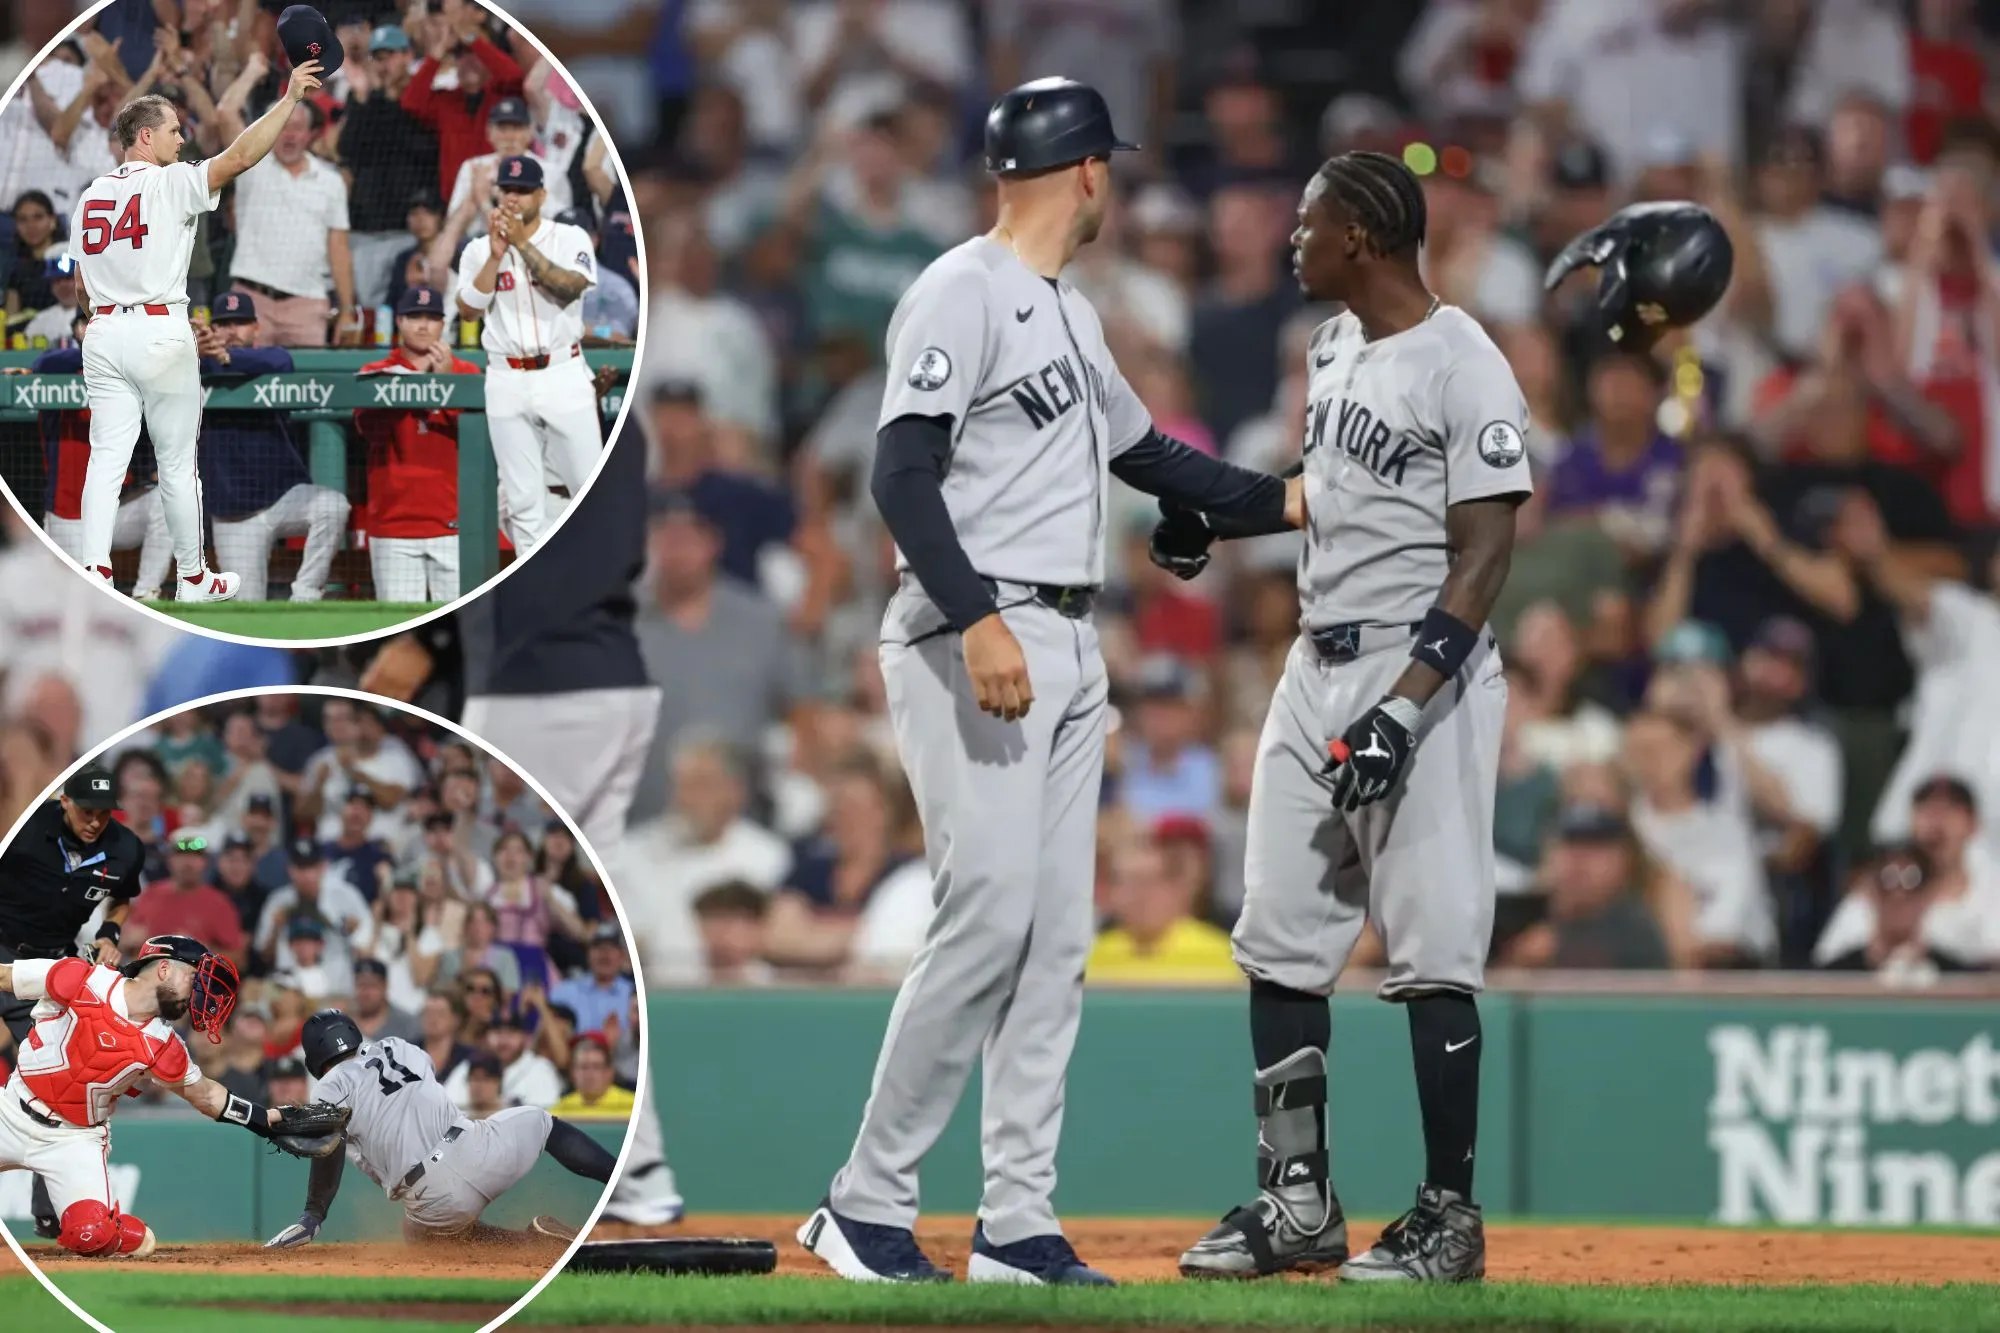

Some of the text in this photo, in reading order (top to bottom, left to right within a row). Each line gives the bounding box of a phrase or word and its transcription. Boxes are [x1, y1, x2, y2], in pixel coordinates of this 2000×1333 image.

[82, 193, 149, 256] 54
[253, 376, 335, 408] xfinity
[373, 375, 455, 407] xfinity
[1010, 354, 1084, 431] NEW
[1335, 398, 1425, 488] YORK
